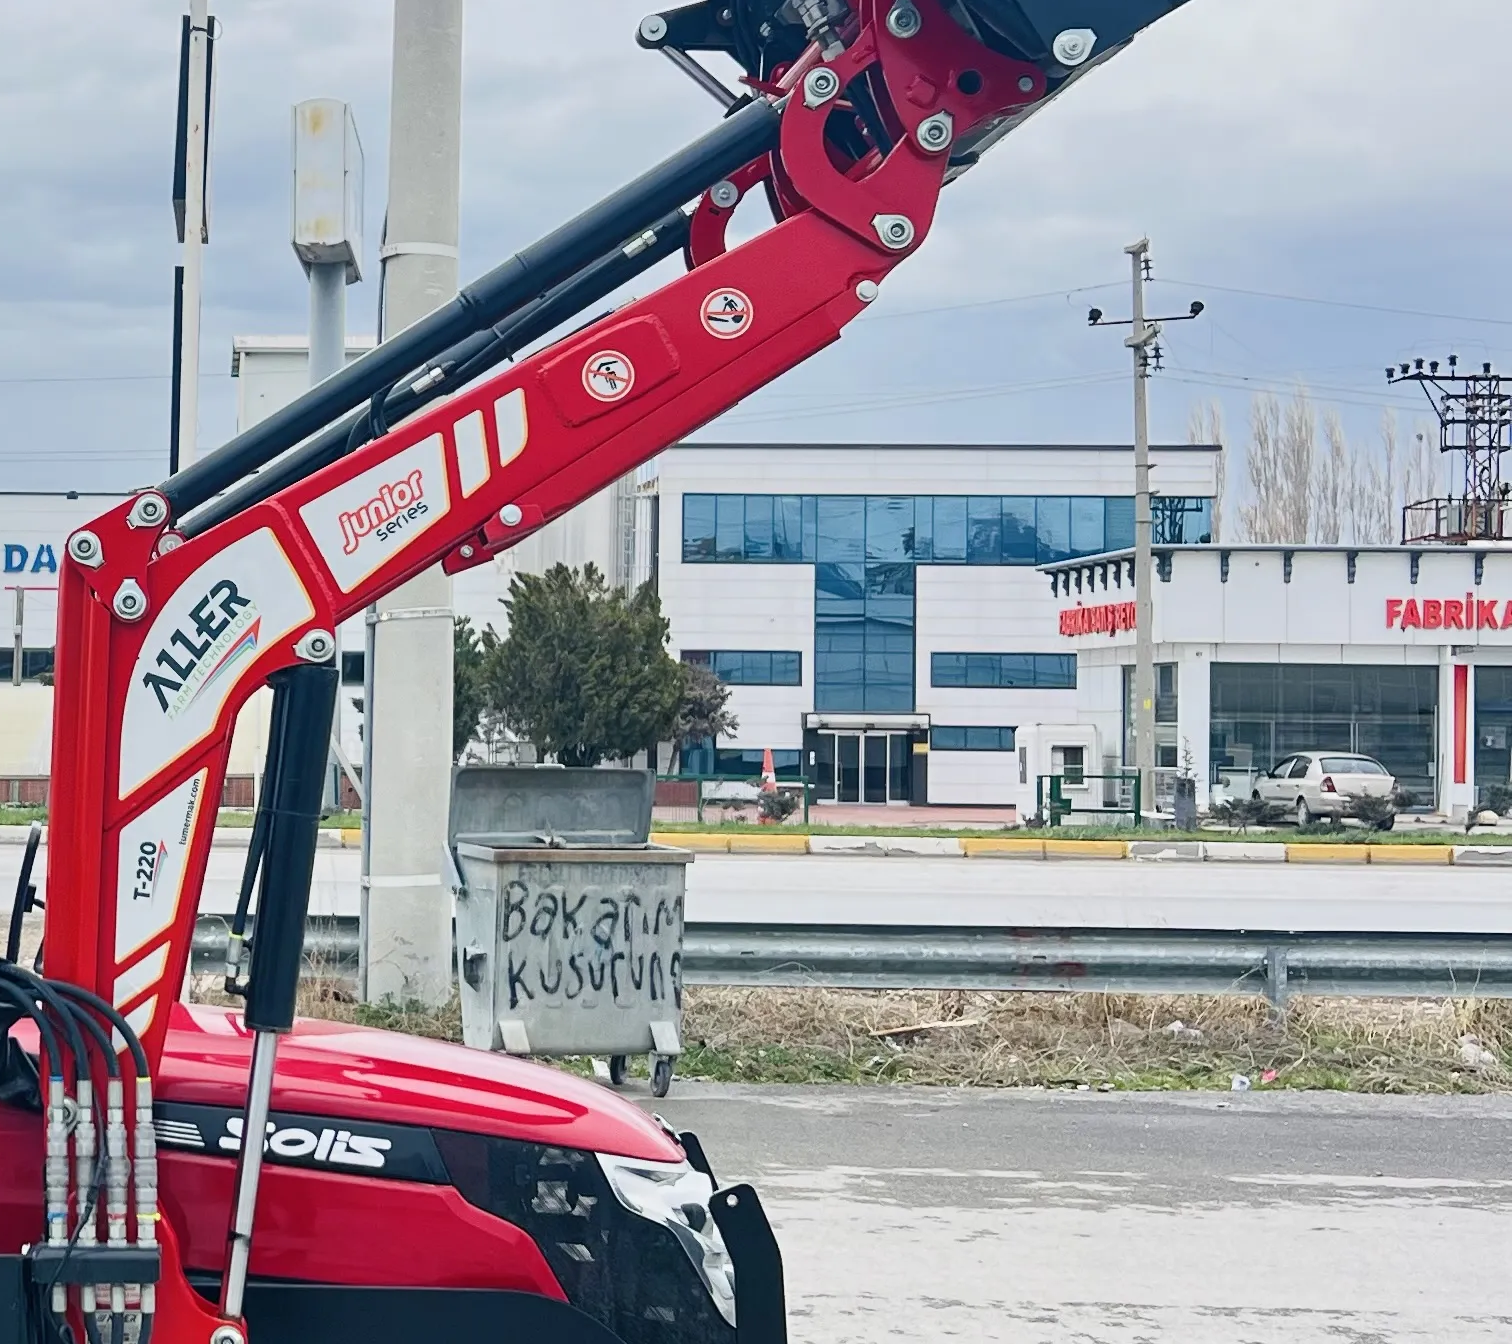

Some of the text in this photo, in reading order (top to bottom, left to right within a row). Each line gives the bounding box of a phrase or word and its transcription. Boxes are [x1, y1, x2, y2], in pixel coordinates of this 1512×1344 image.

[338, 468, 424, 556] junior
[376, 501, 429, 542] series
[142, 579, 252, 714] ALLER
[167, 602, 259, 721] FARM TECHNOLOGY
[133, 841, 157, 900] T-220
